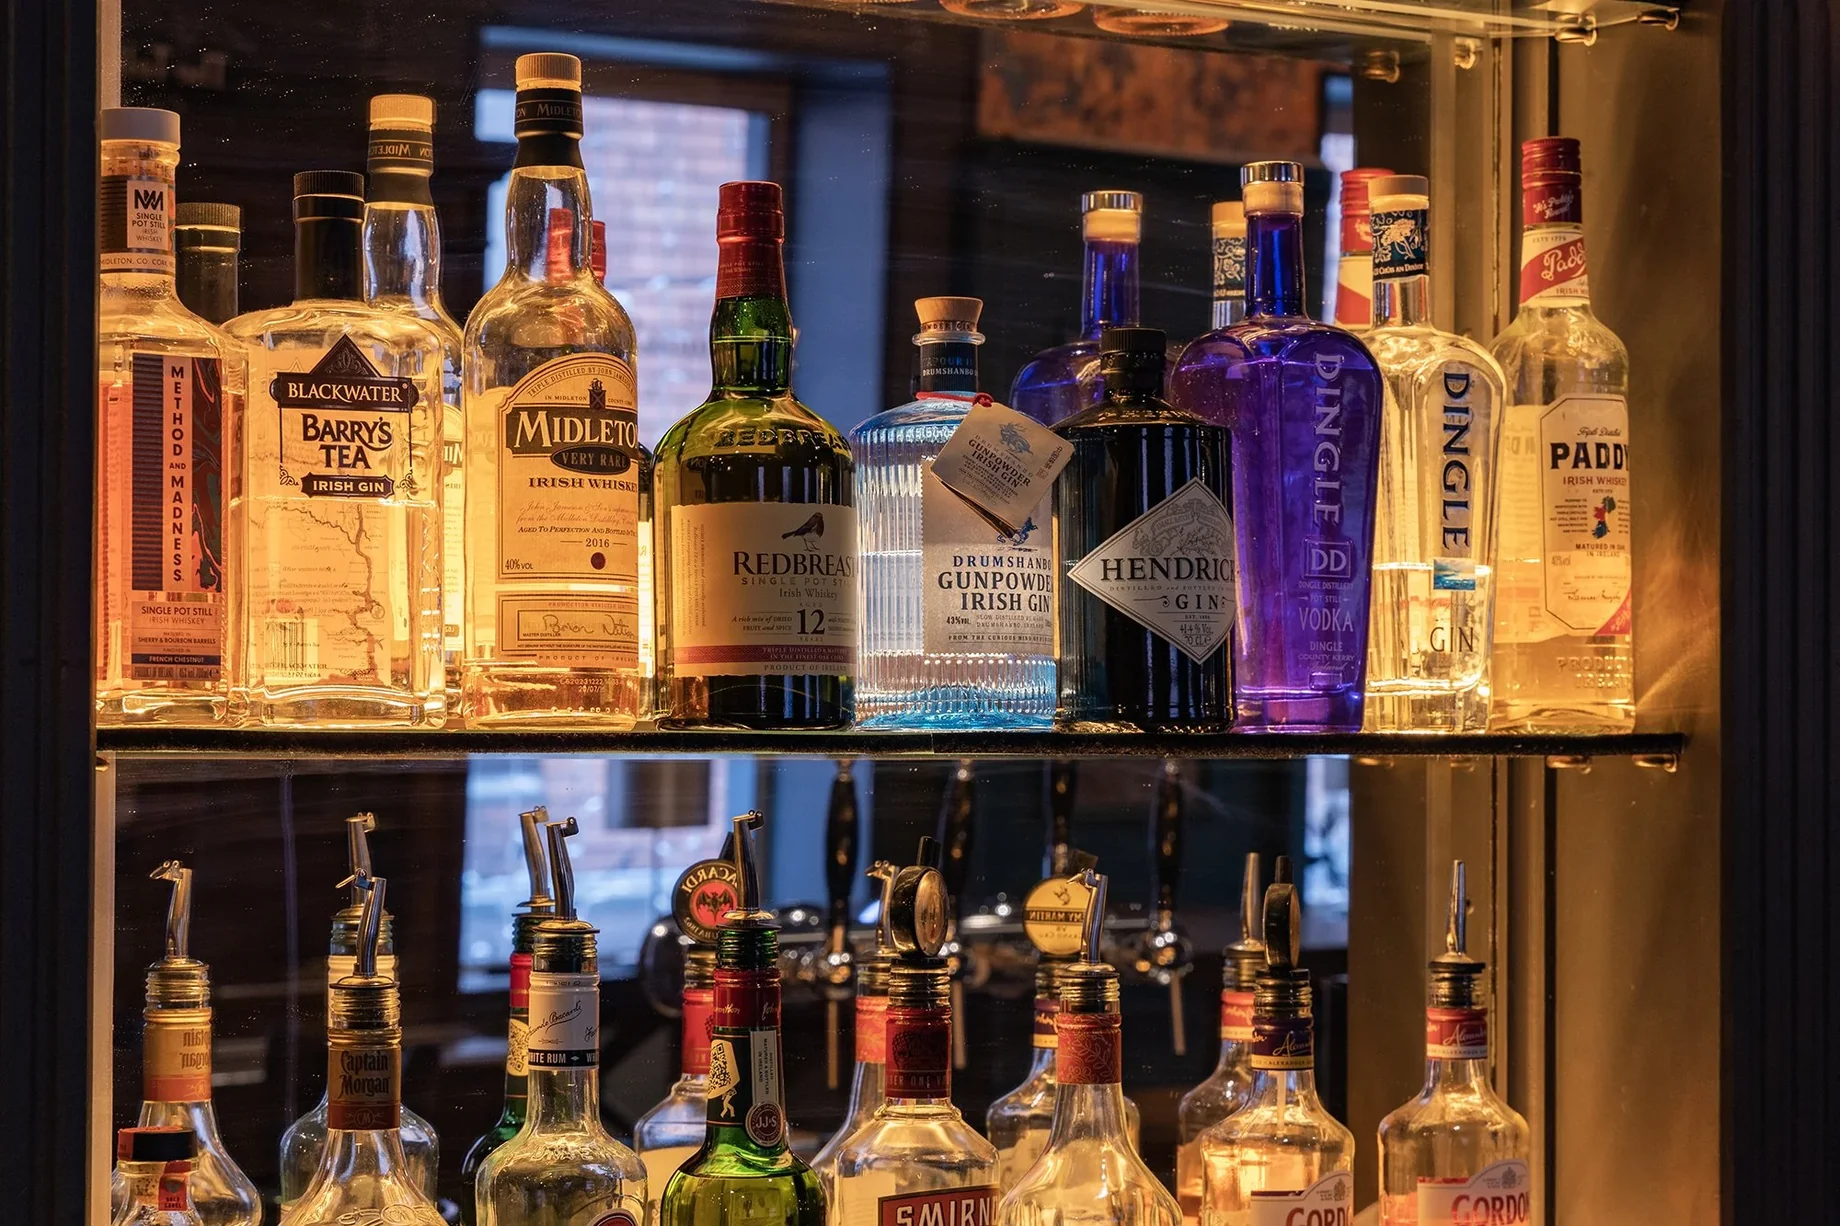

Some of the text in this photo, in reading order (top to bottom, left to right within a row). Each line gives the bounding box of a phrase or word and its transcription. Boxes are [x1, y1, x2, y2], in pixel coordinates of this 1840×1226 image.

[132, 220, 166, 229] POT STILL
[137, 213, 162, 221] SINGLE
[137, 235, 162, 243] WHISKEY
[527, 379, 548, 397] TRIPLE
[551, 368, 585, 382] DISTILLED
[288, 382, 403, 403] BLACKWATER
[171, 366, 184, 456] METHOD
[301, 413, 392, 452] BARRY'S
[514, 410, 637, 448] MIDLETO
[1314, 353, 1342, 525] DINGLE
[319, 445, 371, 469] TEA
[562, 452, 627, 467] VERY RARE
[968, 438, 1031, 486] GUNPOWDER
[1443, 372, 1470, 550] DINGLE
[971, 450, 999, 472] IRISH
[1000, 471, 1019, 488] GIN
[313, 480, 384, 492] IRISH GIN
[529, 478, 637, 493] IRISH WHISKE
[1563, 477, 1593, 486] IRISH
[586, 538, 610, 547] 2016
[953, 556, 1051, 571] DRUMSHANBO
[1311, 549, 1347, 572] DD
[741, 577, 795, 585] SINGLE
[1299, 581, 1320, 589] DINGLE
[779, 588, 838, 600] Irish Whiskey
[1175, 594, 1219, 609] GIN
[961, 593, 1050, 612] IRISH GIN
[141, 606, 172, 615] SINGLE
[174, 606, 191, 616] POT
[193, 608, 213, 616] STILL
[150, 616, 205, 625] IRISH WHISKEY
[797, 609, 825, 635] 12
[1299, 607, 1354, 632] VODKA
[1310, 642, 1343, 651] DINGLE
[1430, 627, 1474, 652] GIN
[1298, 654, 1329, 662] COUNTY
[340, 1050, 388, 1072] Captain
[547, 1053, 566, 1063] RUM
[337, 1074, 390, 1098] Morgan
